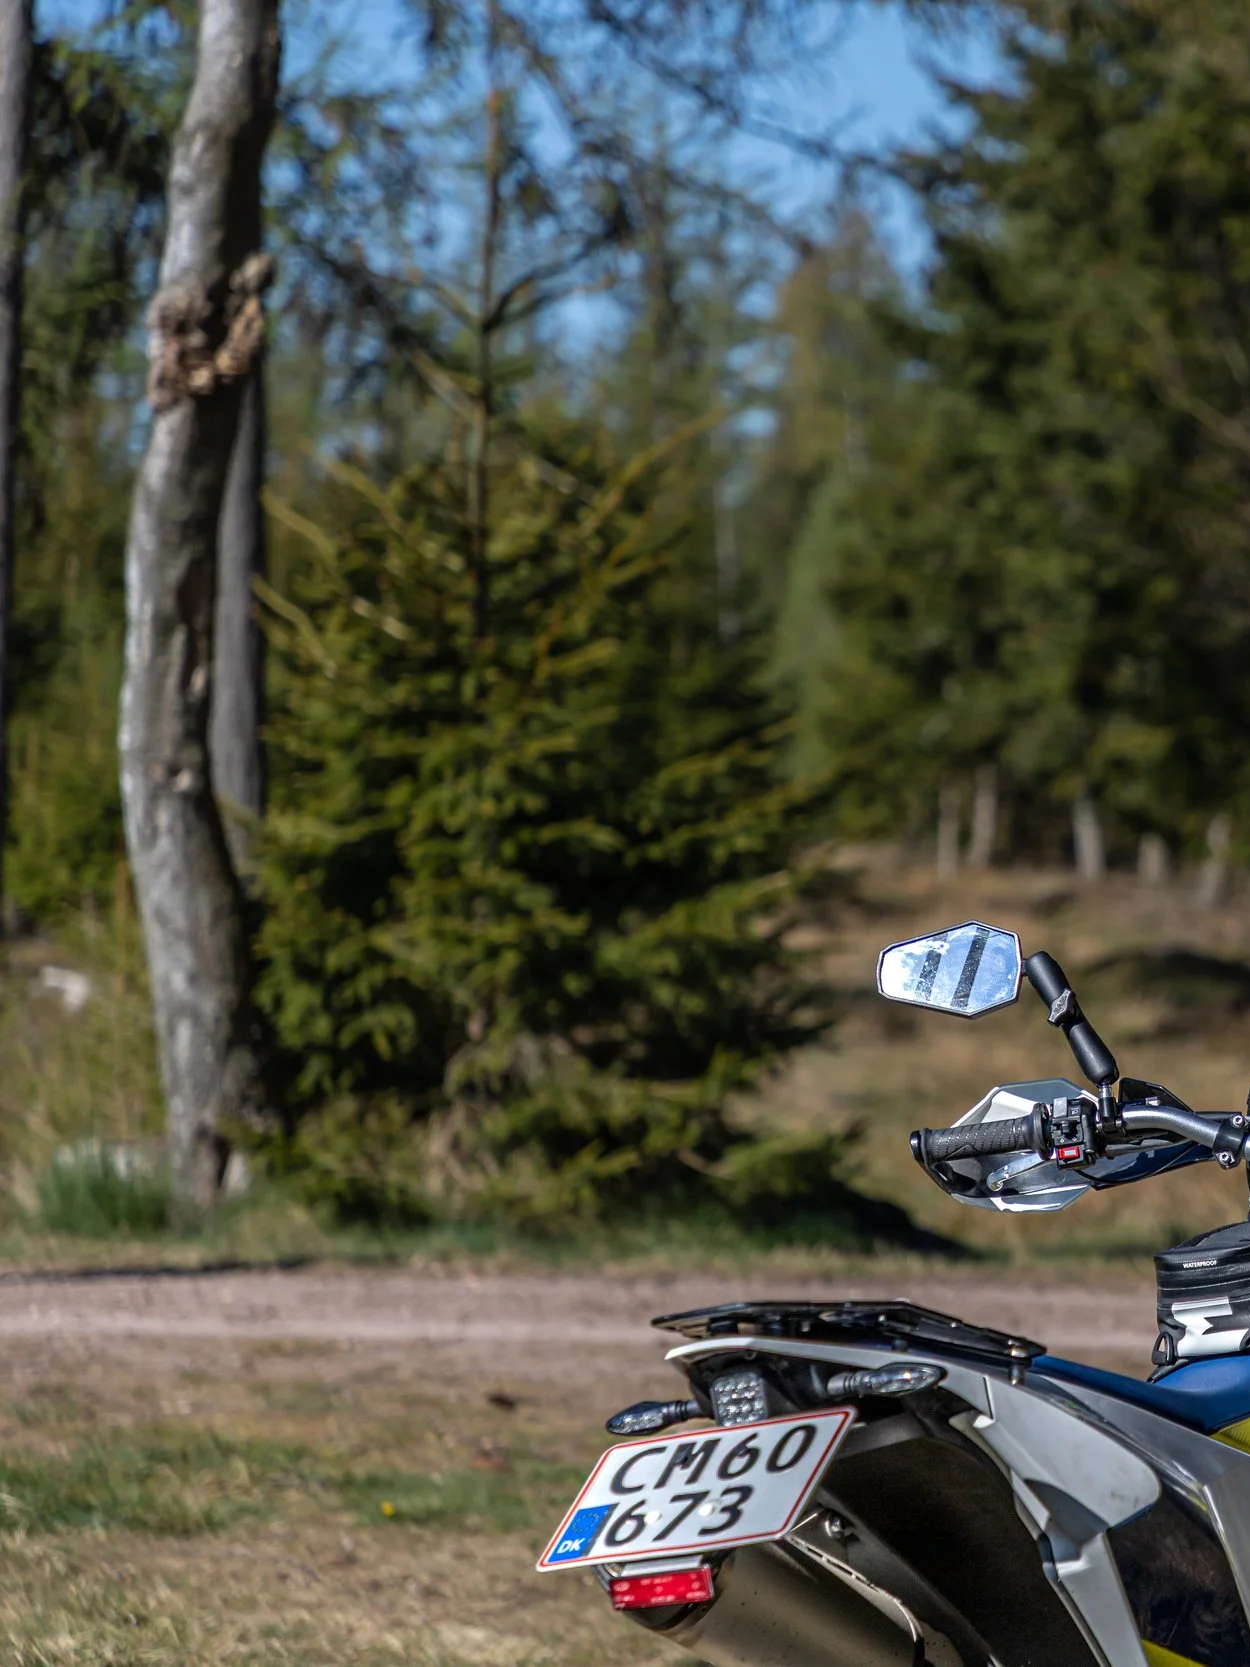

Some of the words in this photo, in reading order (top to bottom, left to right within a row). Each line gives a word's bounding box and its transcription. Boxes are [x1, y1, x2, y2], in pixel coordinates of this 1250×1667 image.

[1183, 1260, 1217, 1269] WATERPROOF
[605, 1485, 754, 1548] 673
[557, 1537, 586, 1554] DK
